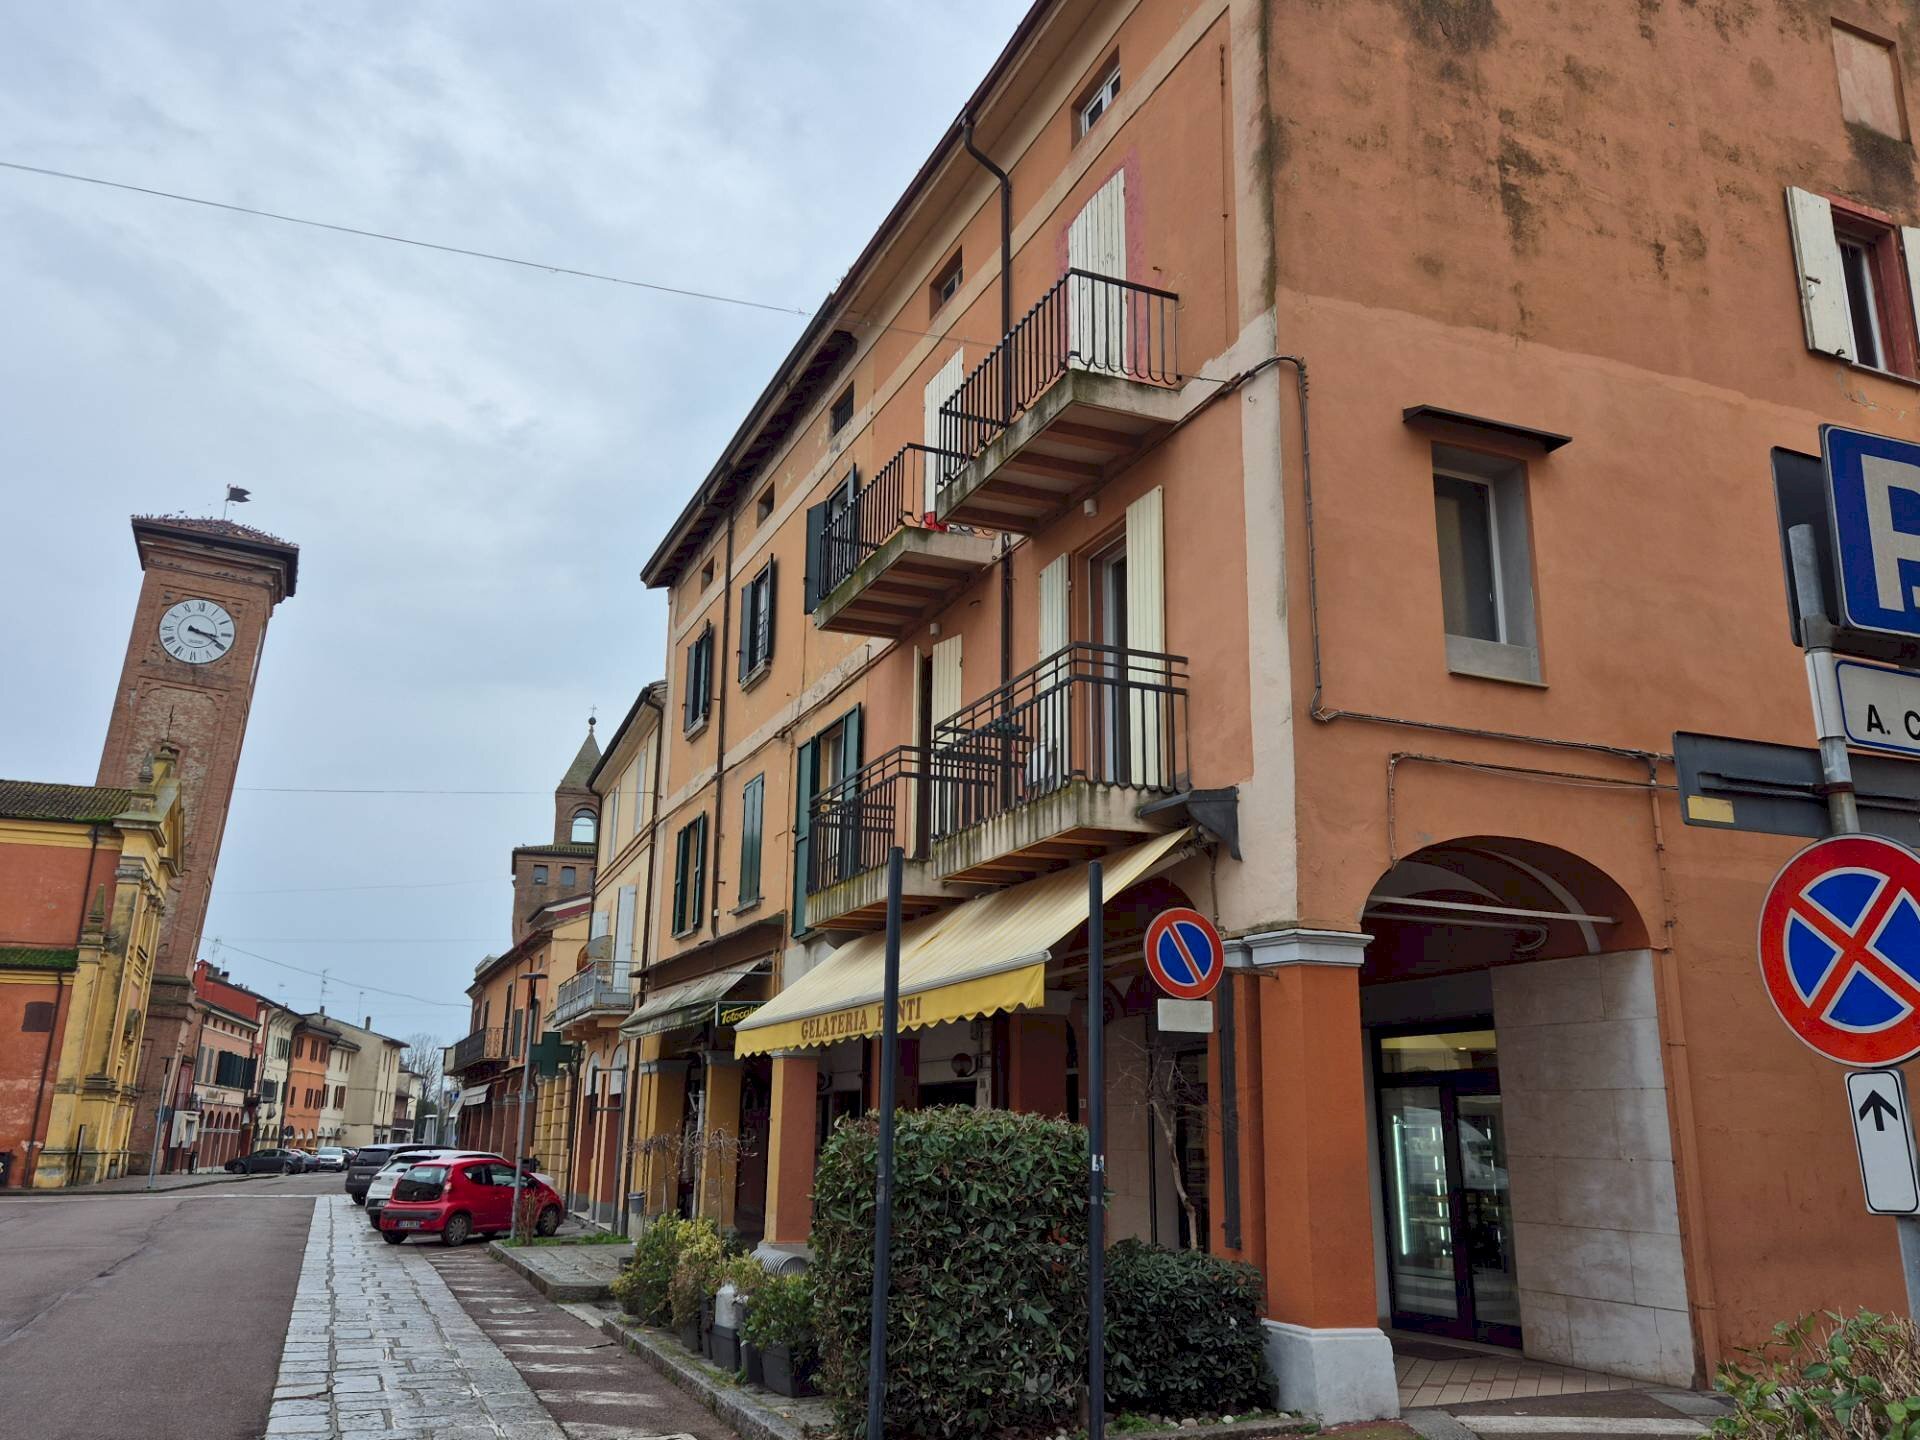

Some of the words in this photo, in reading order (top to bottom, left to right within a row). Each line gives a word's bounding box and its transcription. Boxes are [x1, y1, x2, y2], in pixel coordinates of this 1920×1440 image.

[1867, 704, 1891, 735] A.
[801, 1009, 868, 1040] GELATERIA
[877, 997, 922, 1027] PNTI
